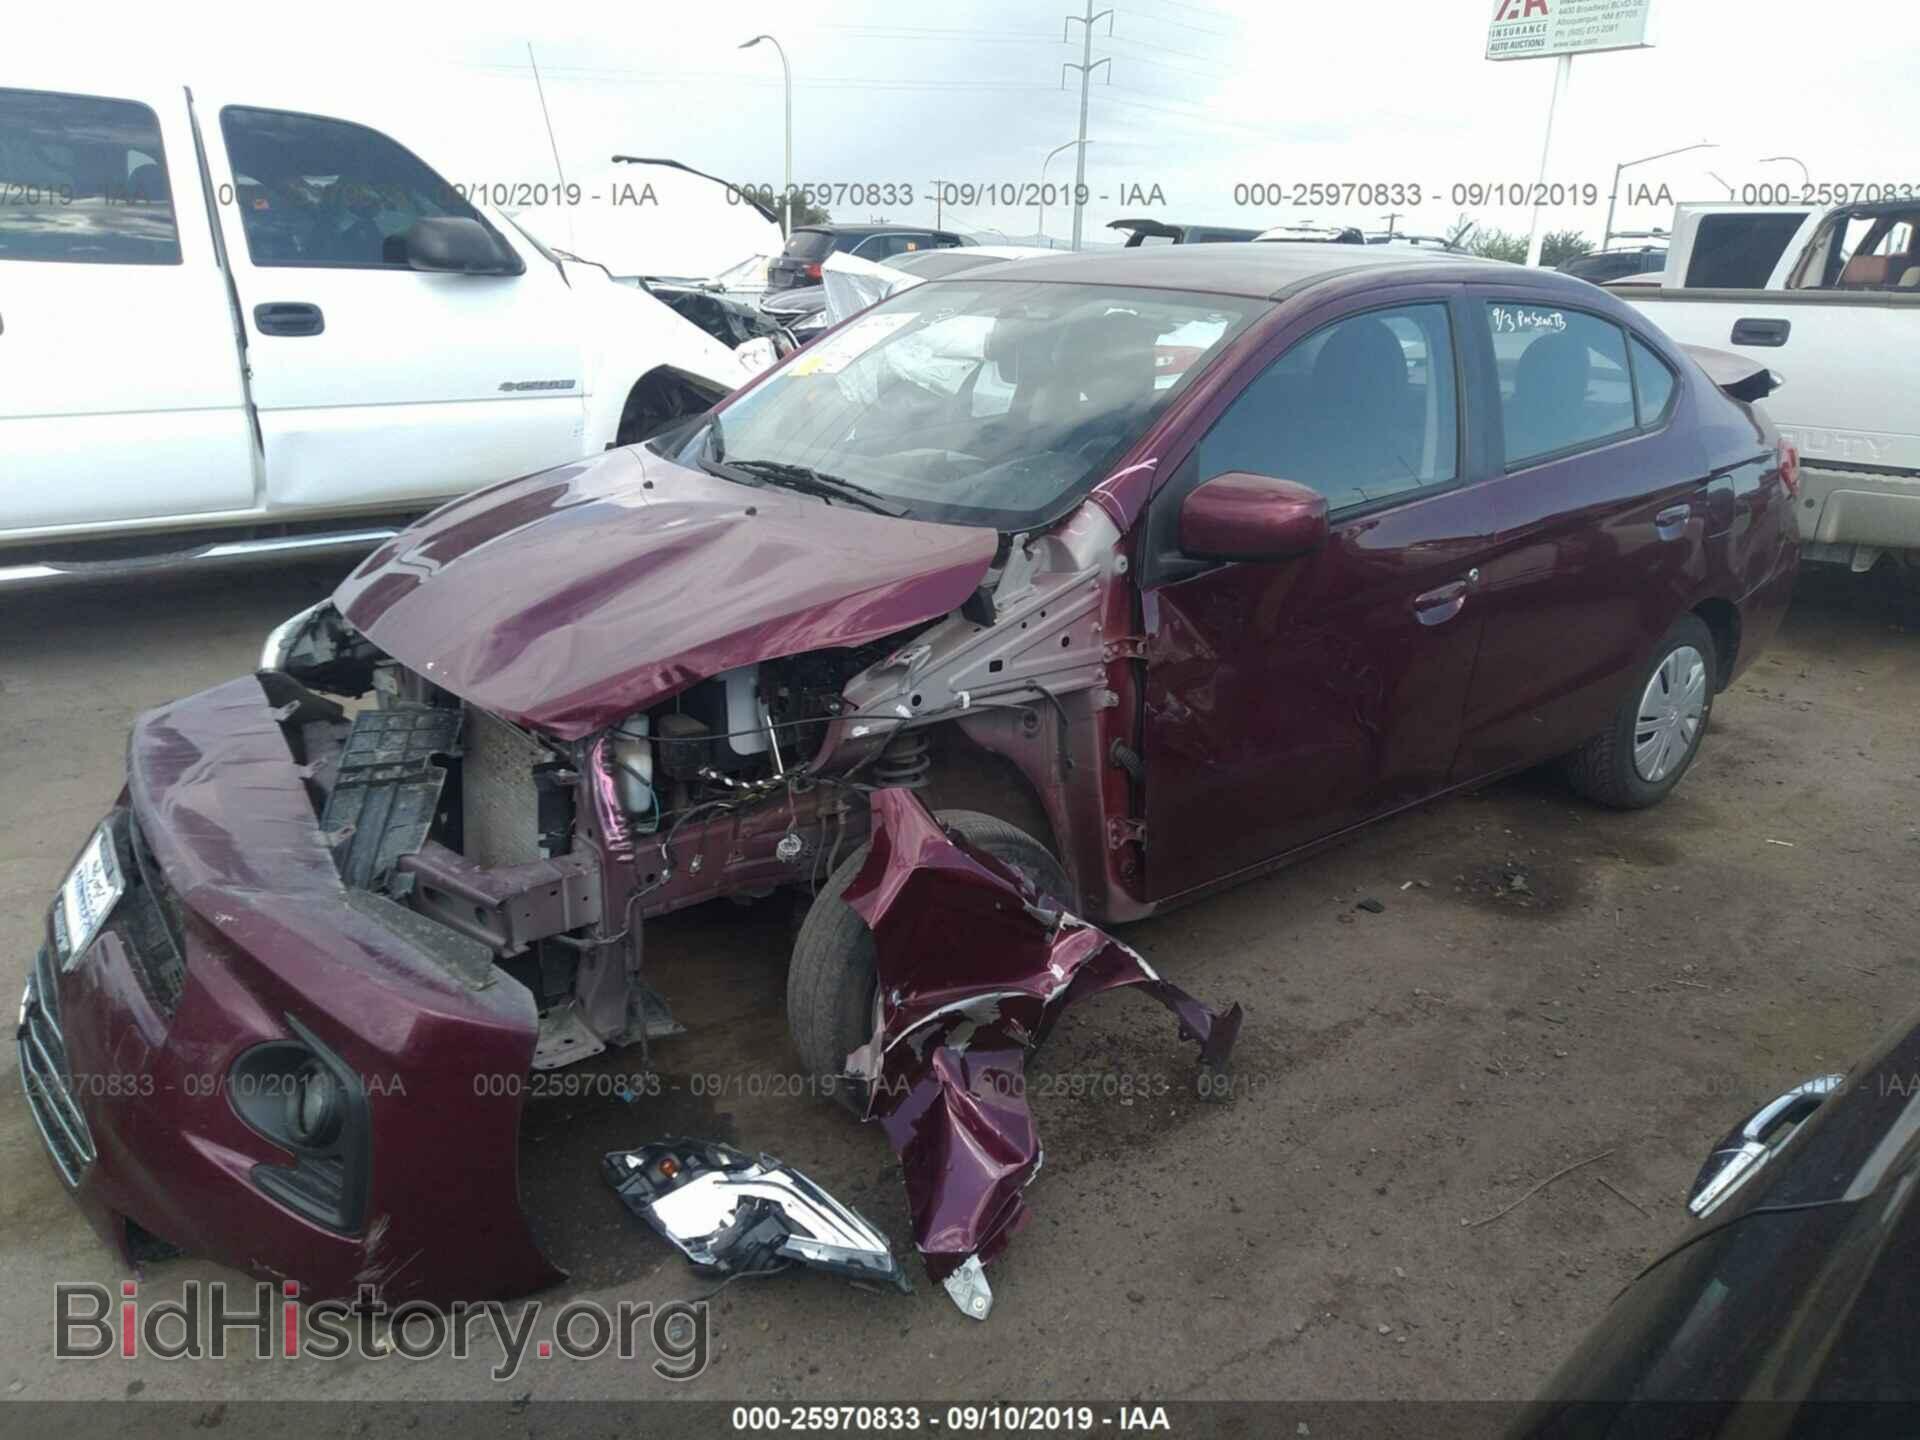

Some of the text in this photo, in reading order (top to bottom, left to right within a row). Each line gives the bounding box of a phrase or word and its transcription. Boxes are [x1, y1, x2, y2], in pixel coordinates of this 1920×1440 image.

[1491, 23, 1548, 38] INSURANCE
[1489, 38, 1546, 51] AUTO AUCTIONS
